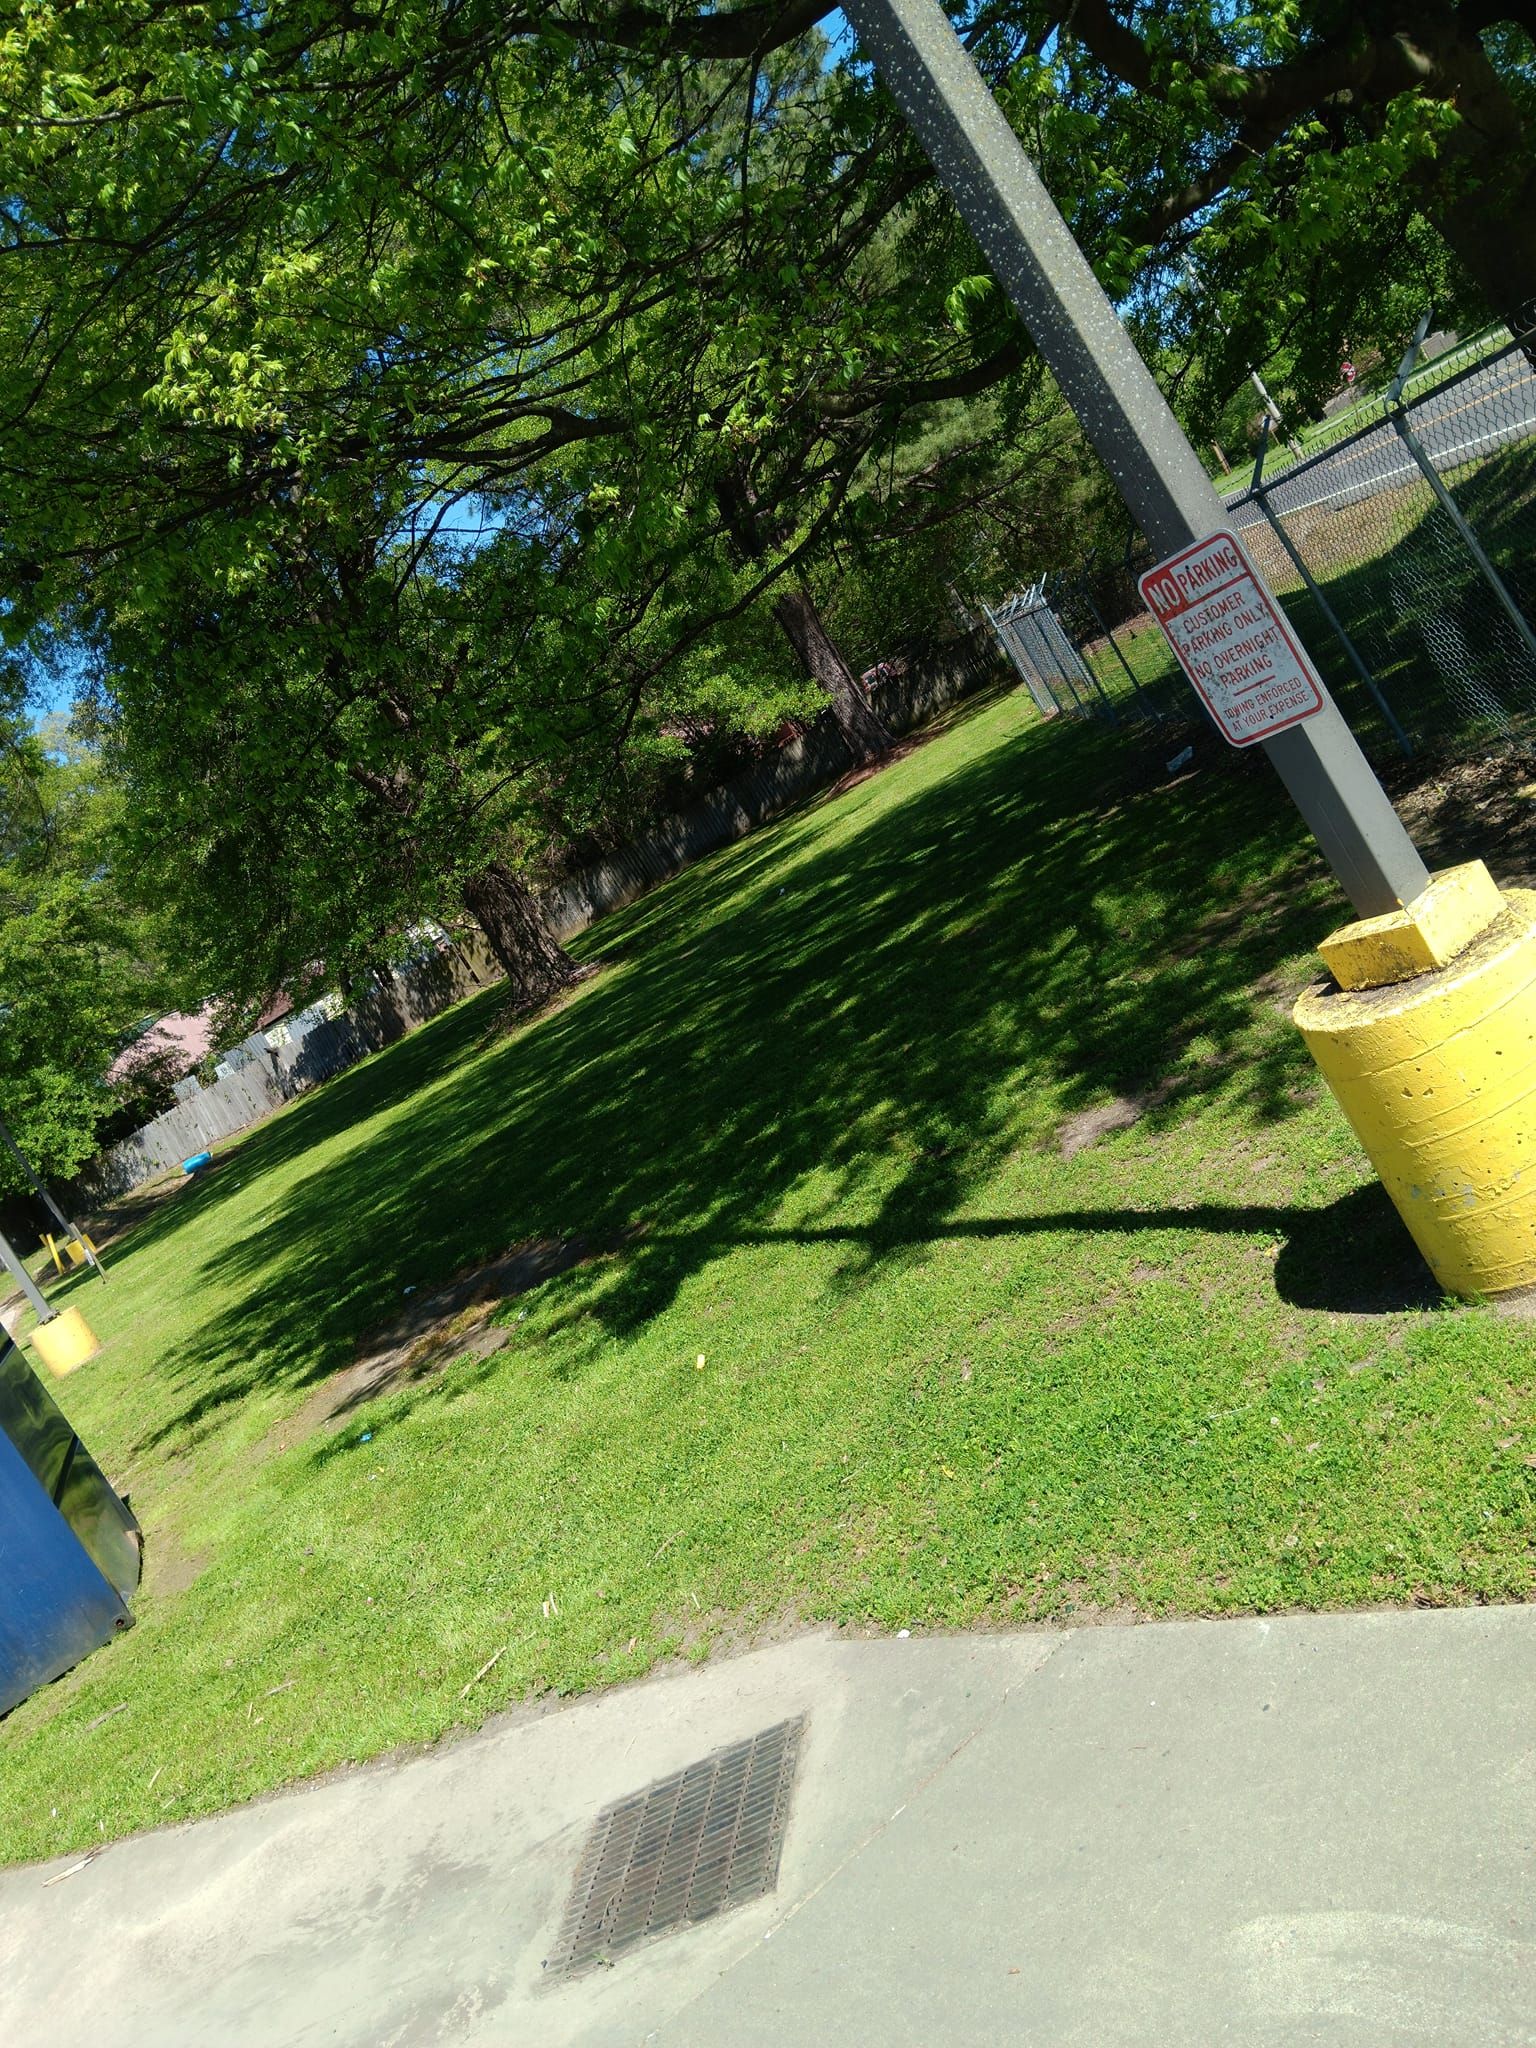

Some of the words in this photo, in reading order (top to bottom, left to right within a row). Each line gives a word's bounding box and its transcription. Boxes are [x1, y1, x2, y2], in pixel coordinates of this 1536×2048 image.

[1149, 577, 1180, 615] NO
[1177, 547, 1238, 594] PARKING
[1182, 622, 1232, 657] PARKING
[1234, 603, 1266, 629] ONLY
[1183, 592, 1245, 633] CUSTOMER
[1195, 661, 1212, 679] NO
[1213, 626, 1279, 669] OVERNIGHT
[1220, 654, 1273, 689] PARKING
[1224, 699, 1255, 719] TOWING
[1256, 677, 1302, 706] ENFORCED
[1232, 721, 1243, 732] AT
[1243, 709, 1268, 727] YOUR
[1268, 690, 1309, 716] EXPENSE
